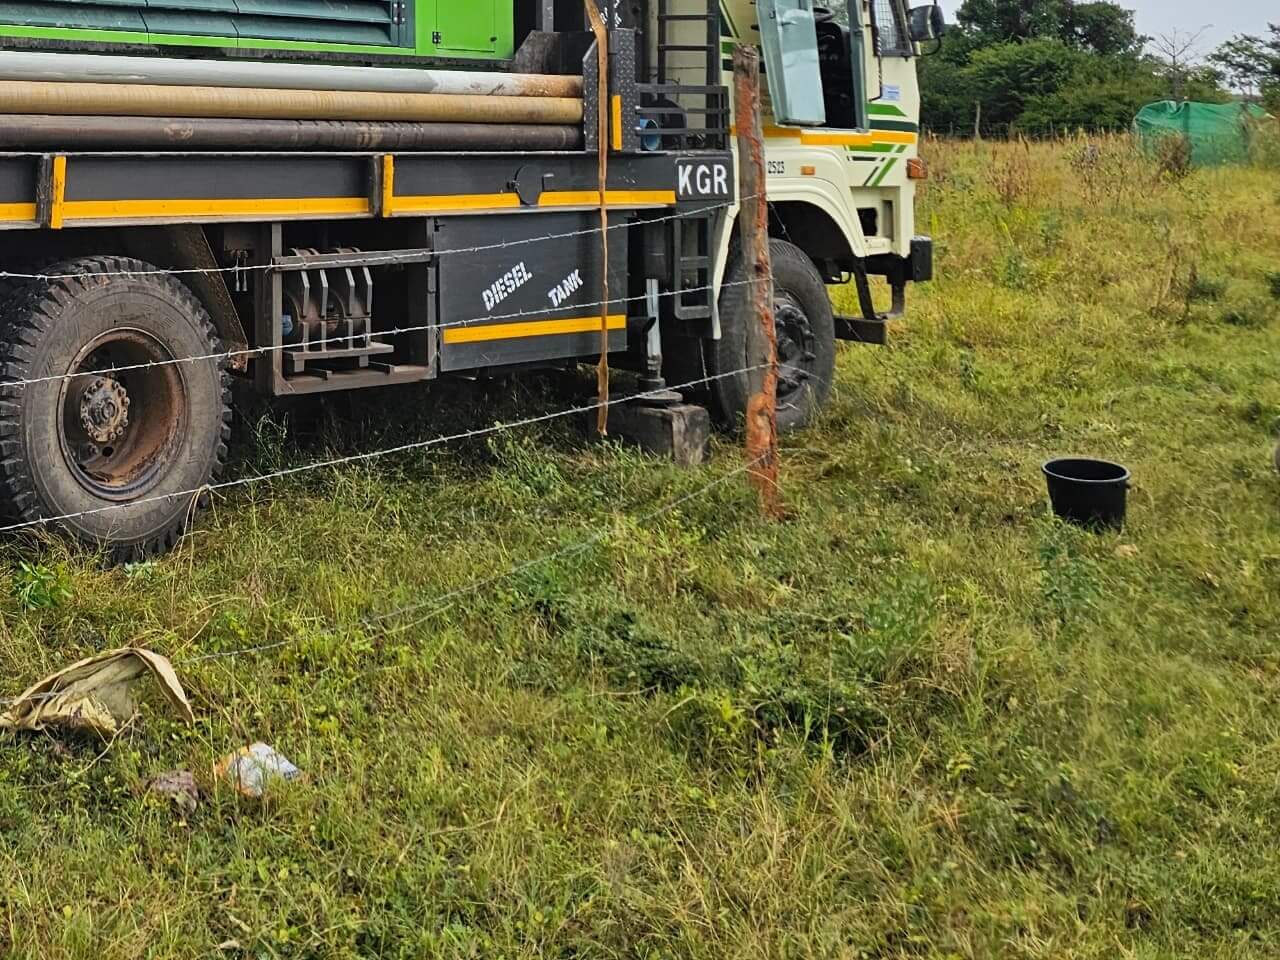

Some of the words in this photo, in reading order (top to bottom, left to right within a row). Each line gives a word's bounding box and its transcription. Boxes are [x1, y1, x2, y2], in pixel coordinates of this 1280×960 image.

[678, 164, 729, 196] KGR
[481, 261, 533, 312] DIESEL
[547, 268, 584, 307] TANK
